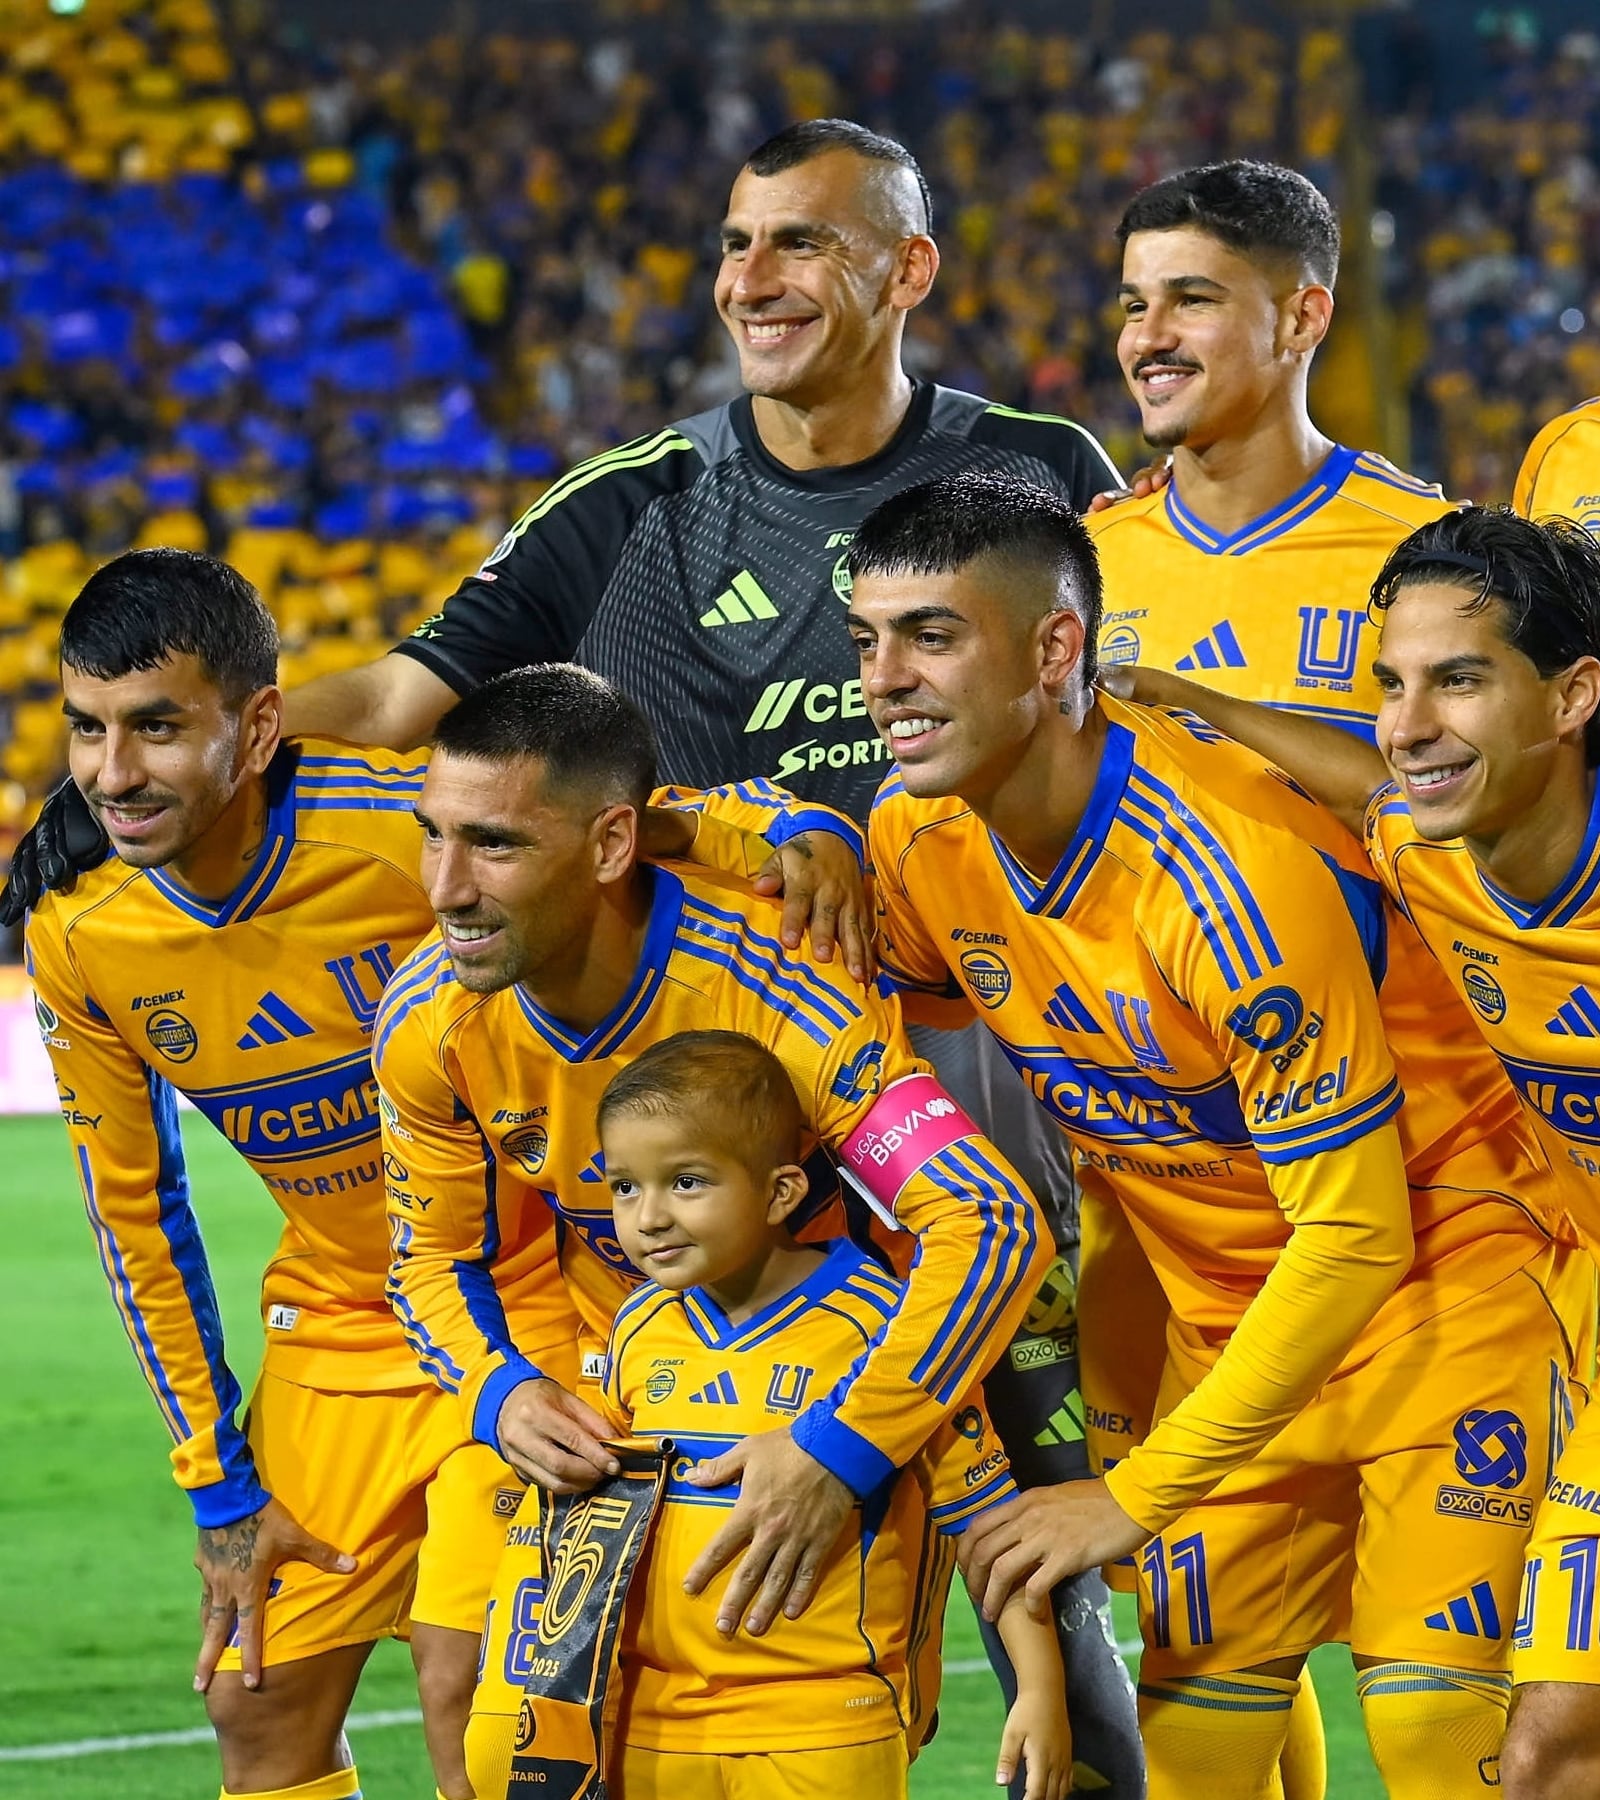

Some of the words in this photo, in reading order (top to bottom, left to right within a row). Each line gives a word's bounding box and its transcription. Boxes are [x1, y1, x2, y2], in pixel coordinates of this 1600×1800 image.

[1111, 608, 1149, 624] CEMEX
[963, 932, 1008, 946] CEMEX
[1462, 946, 1500, 967] CEMEX
[144, 990, 186, 1008] CEMEX
[1270, 1010, 1325, 1075] Berel
[1254, 1055, 1348, 1125] telcel
[61, 1109, 103, 1130] REY
[257, 1079, 382, 1144] CEME
[506, 1106, 549, 1124] CEMEX
[1051, 1082, 1201, 1135] CEMEX
[852, 1131, 879, 1166] LIGA
[869, 1109, 933, 1168] BBVA
[1016, 1344, 1054, 1364] OXXO
[1087, 1405, 1135, 1436] EMEX
[1484, 1500, 1532, 1523] GAS
[508, 1526, 541, 1547] EME
[1142, 1532, 1214, 1649] 11
[530, 1657, 560, 1678] 2025
